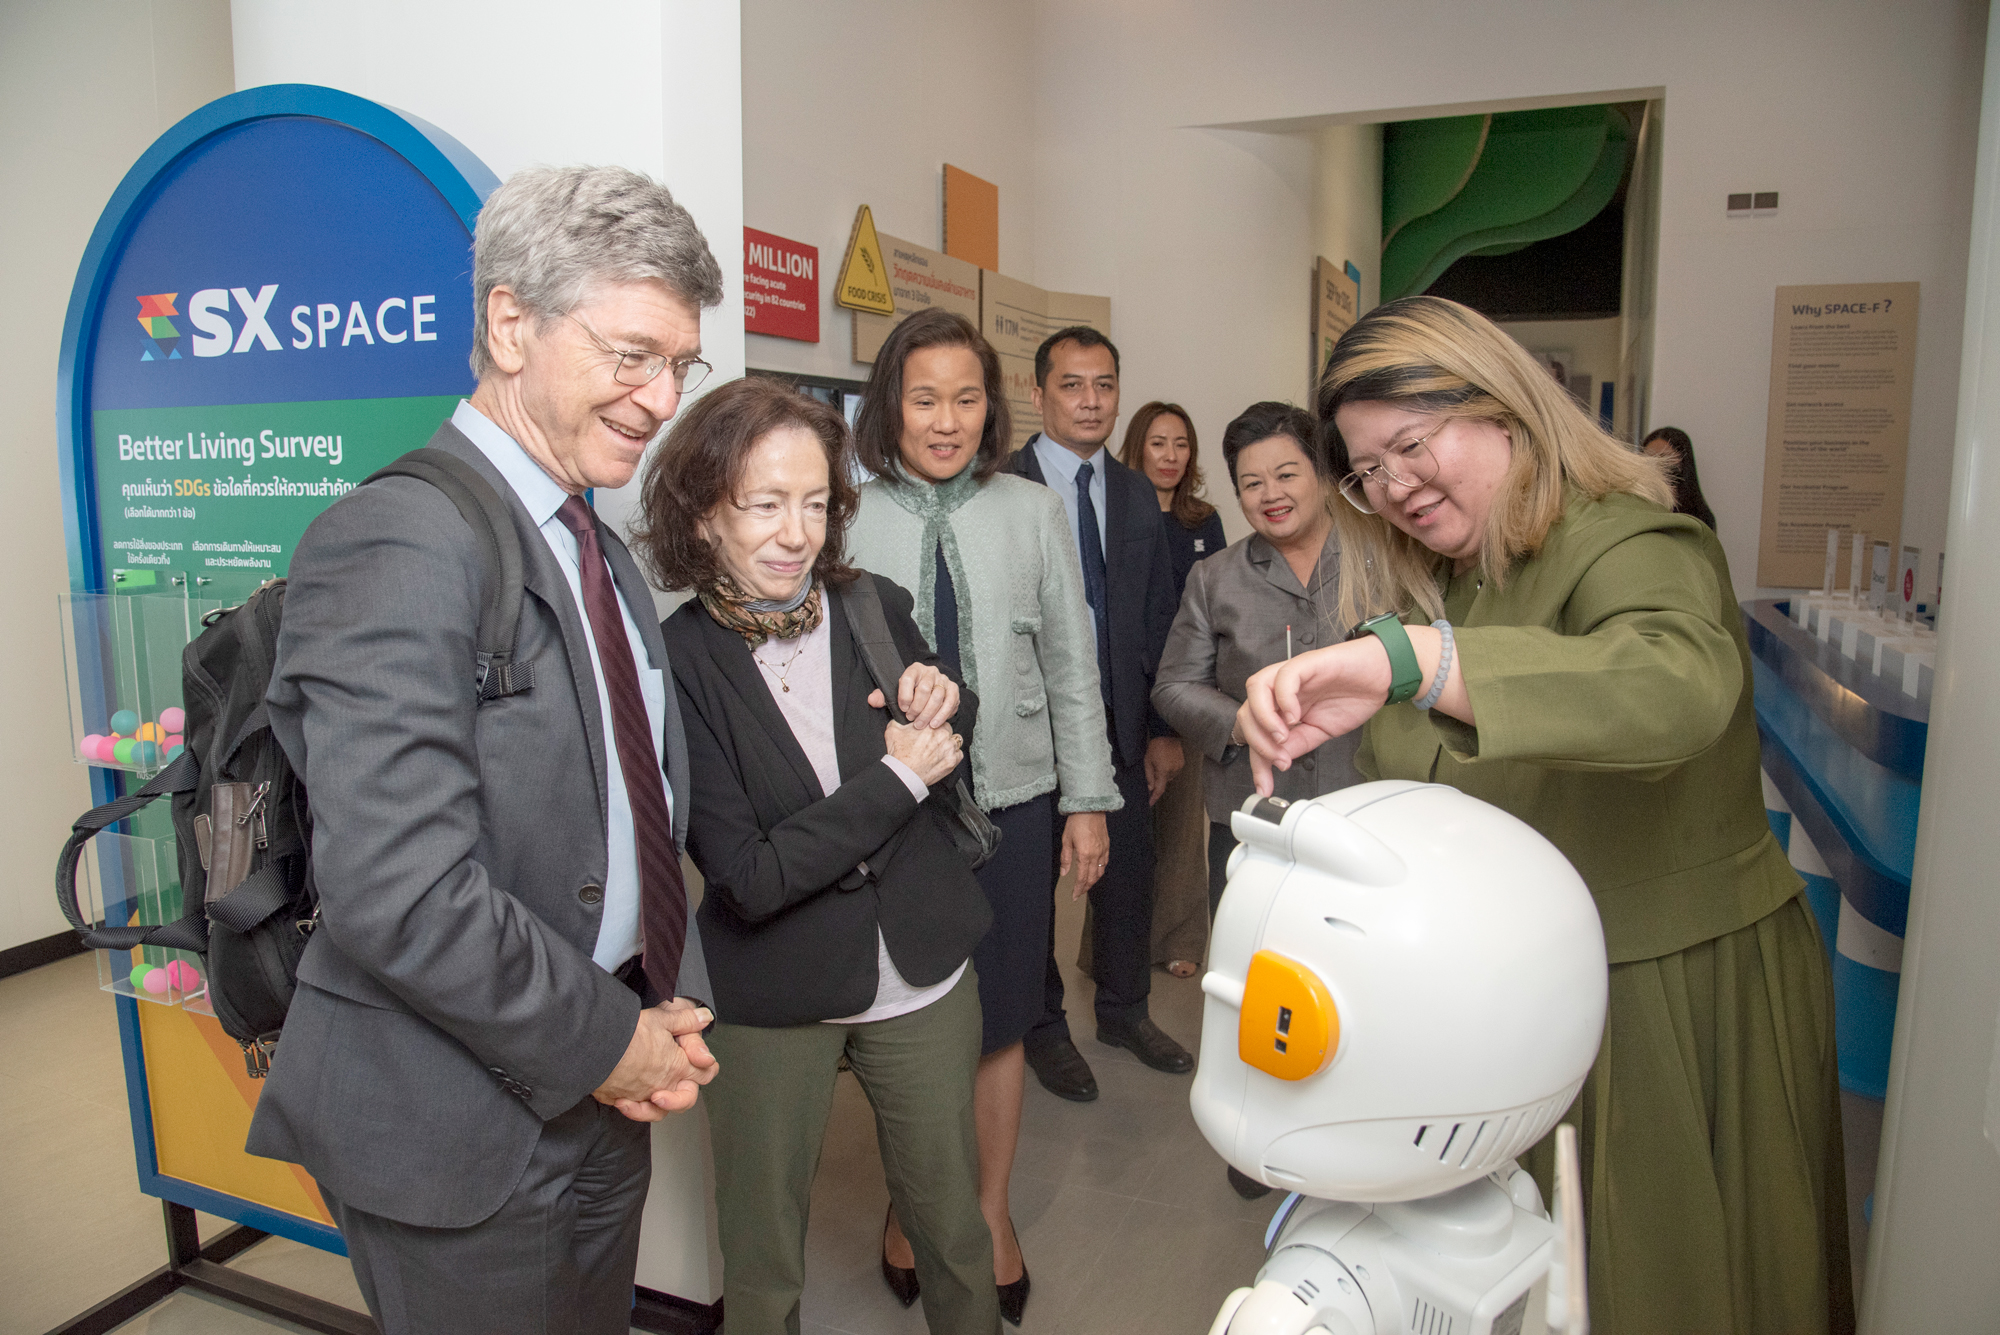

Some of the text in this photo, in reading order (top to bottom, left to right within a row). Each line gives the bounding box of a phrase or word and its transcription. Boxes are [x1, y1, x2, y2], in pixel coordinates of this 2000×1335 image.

[749, 242, 813, 280] MILLION
[750, 273, 769, 289] facing
[770, 278, 787, 291] acute
[771, 295, 779, 305] 82
[779, 299, 806, 311] countries
[848, 286, 887, 304] FOOD CRISIS
[1792, 304, 1821, 317] Why
[1825, 302, 1880, 314] SPACE-F
[188, 284, 438, 358] SX SPACE
[118, 428, 343, 466] Better Living Survey
[122, 478, 173, 501] คุณเห็นว่า
[174, 479, 211, 497] SDGs
[124, 505, 196, 520] (เลือกได้มากกว่า 1 ข้อ)
